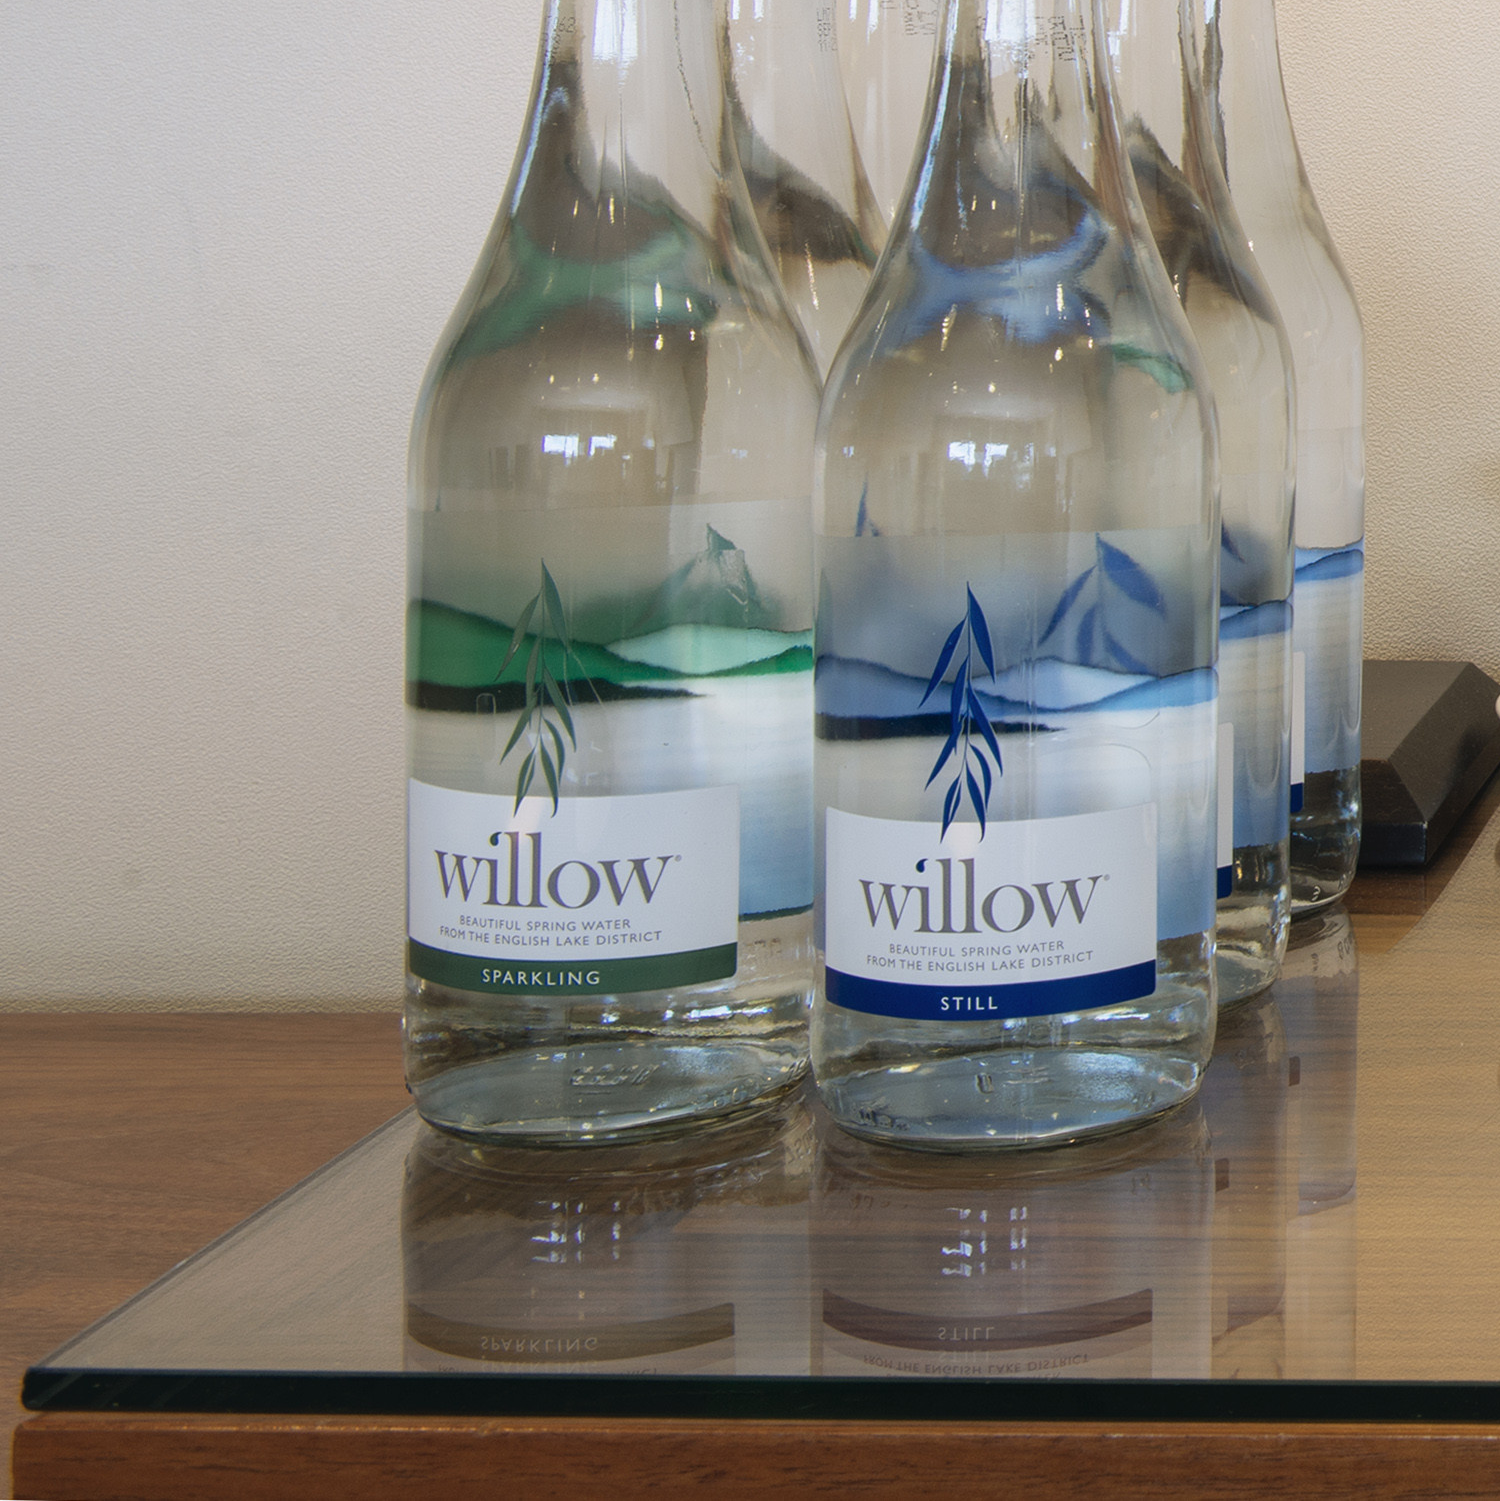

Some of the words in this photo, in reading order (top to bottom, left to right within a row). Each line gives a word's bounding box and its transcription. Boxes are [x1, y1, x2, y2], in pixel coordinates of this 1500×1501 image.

[434, 831, 675, 909] willow
[858, 857, 1103, 934] willow
[460, 914, 521, 931] BEAUTIFUL
[527, 920, 577, 931] SPRING
[582, 918, 631, 931] WATER
[439, 925, 466, 940] FROM
[469, 930, 490, 943] THE
[494, 933, 550, 946] ENGLISH
[556, 935, 589, 946] LAKE
[596, 930, 662, 946] DISTRICT
[889, 943, 955, 957] BEAUTIFUL
[961, 945, 1012, 957] SPRING
[1016, 940, 1065, 954] WATER
[866, 954, 896, 968] FROM
[899, 959, 922, 971] THE
[928, 961, 985, 972] ENGLISH
[992, 958, 1025, 971] LAKE
[1031, 950, 1094, 968] DISTRICT
[481, 968, 600, 986] SPARKLING
[940, 996, 998, 1011] STILL
